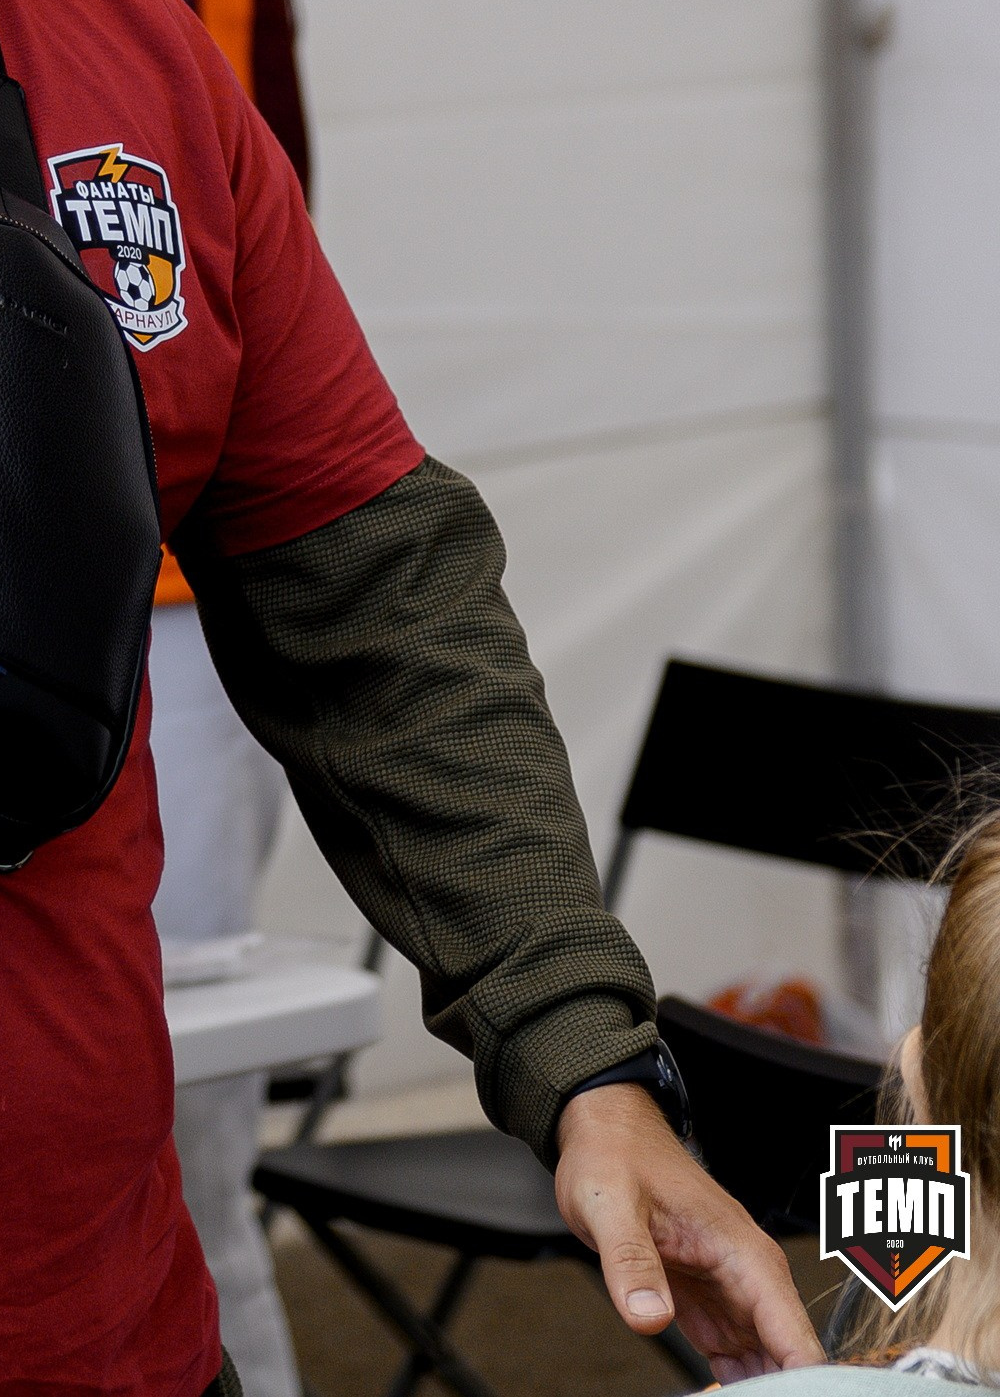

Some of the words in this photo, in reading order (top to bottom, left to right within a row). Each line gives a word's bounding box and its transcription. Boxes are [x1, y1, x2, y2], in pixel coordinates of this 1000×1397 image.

[75, 181, 155, 204] ФАНАТЫ
[65, 200, 175, 255] ТЕМП
[116, 244, 142, 260] 2020
[114, 307, 174, 329] АРНАУЛ
